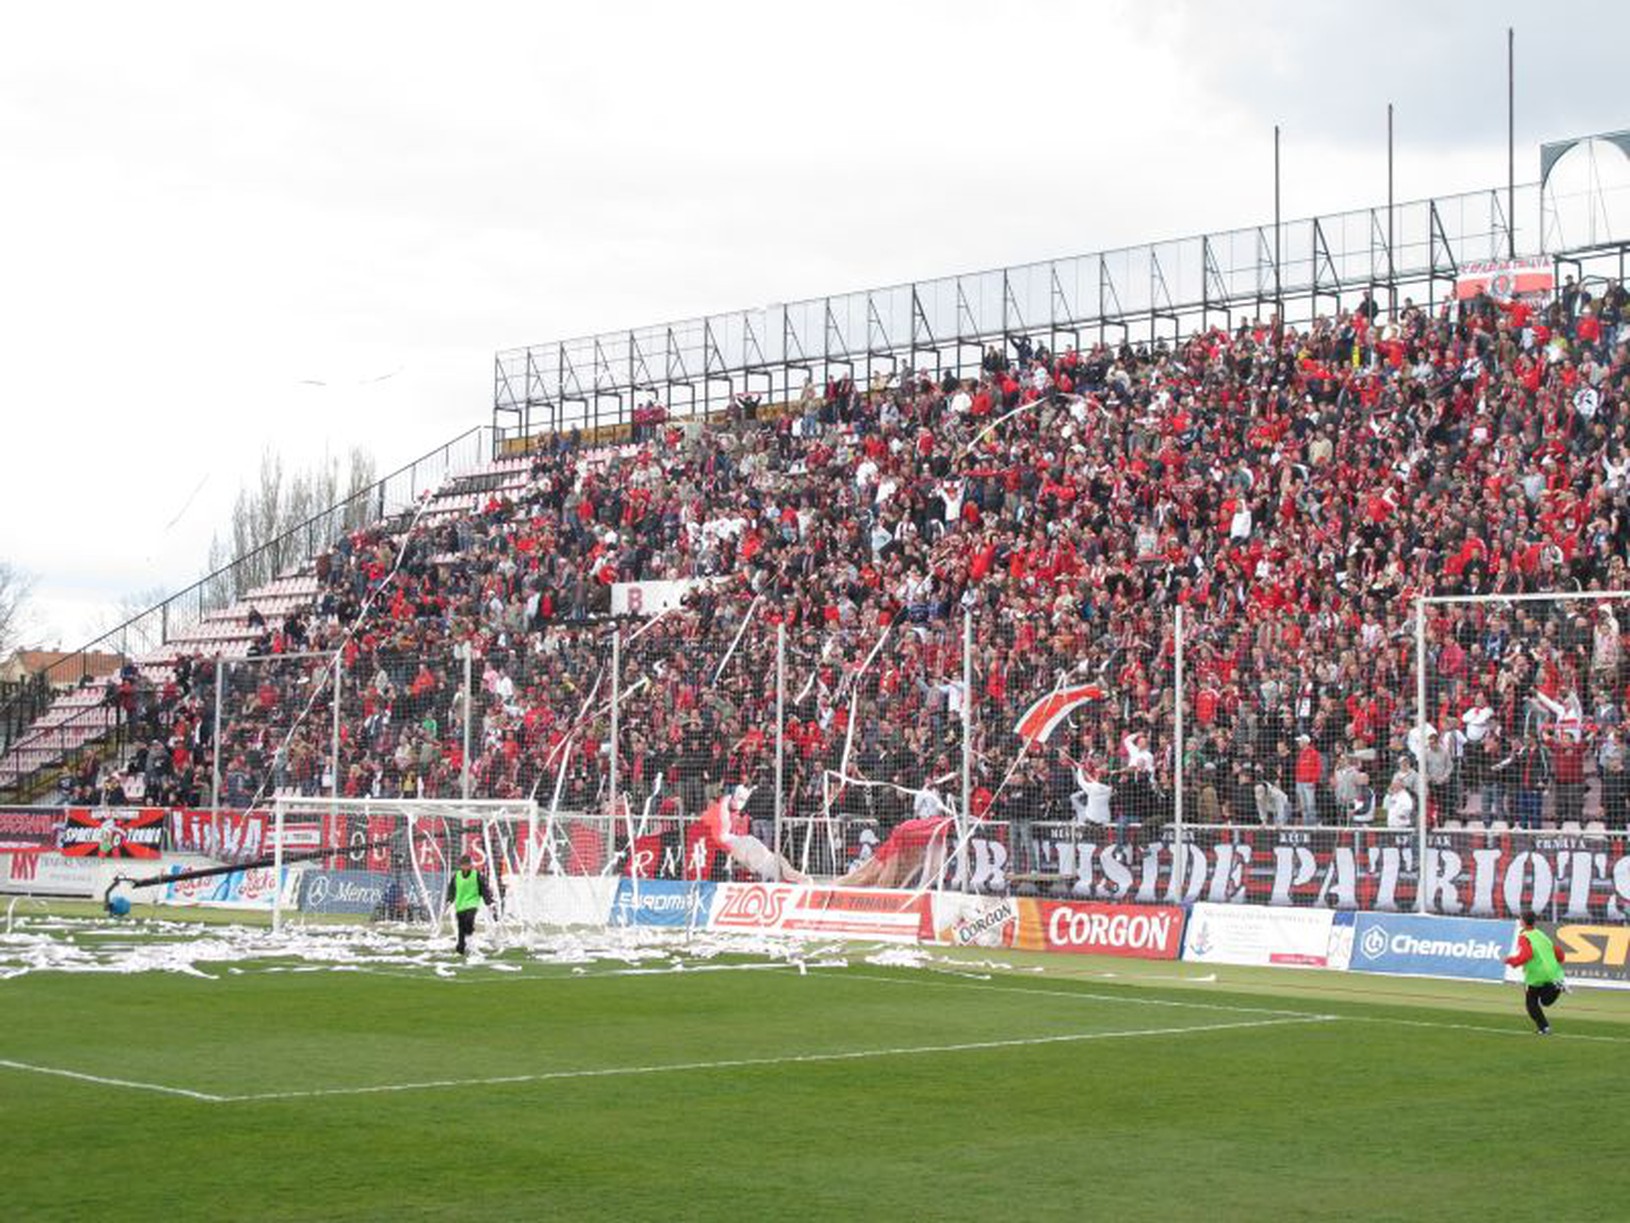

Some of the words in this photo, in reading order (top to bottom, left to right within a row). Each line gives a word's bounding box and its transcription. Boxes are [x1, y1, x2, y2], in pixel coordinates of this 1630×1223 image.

[627, 586, 642, 613] B
[10, 852, 41, 881] MY
[1049, 907, 1172, 951] CORGOŇ
[1391, 933, 1503, 962] Chemolak
